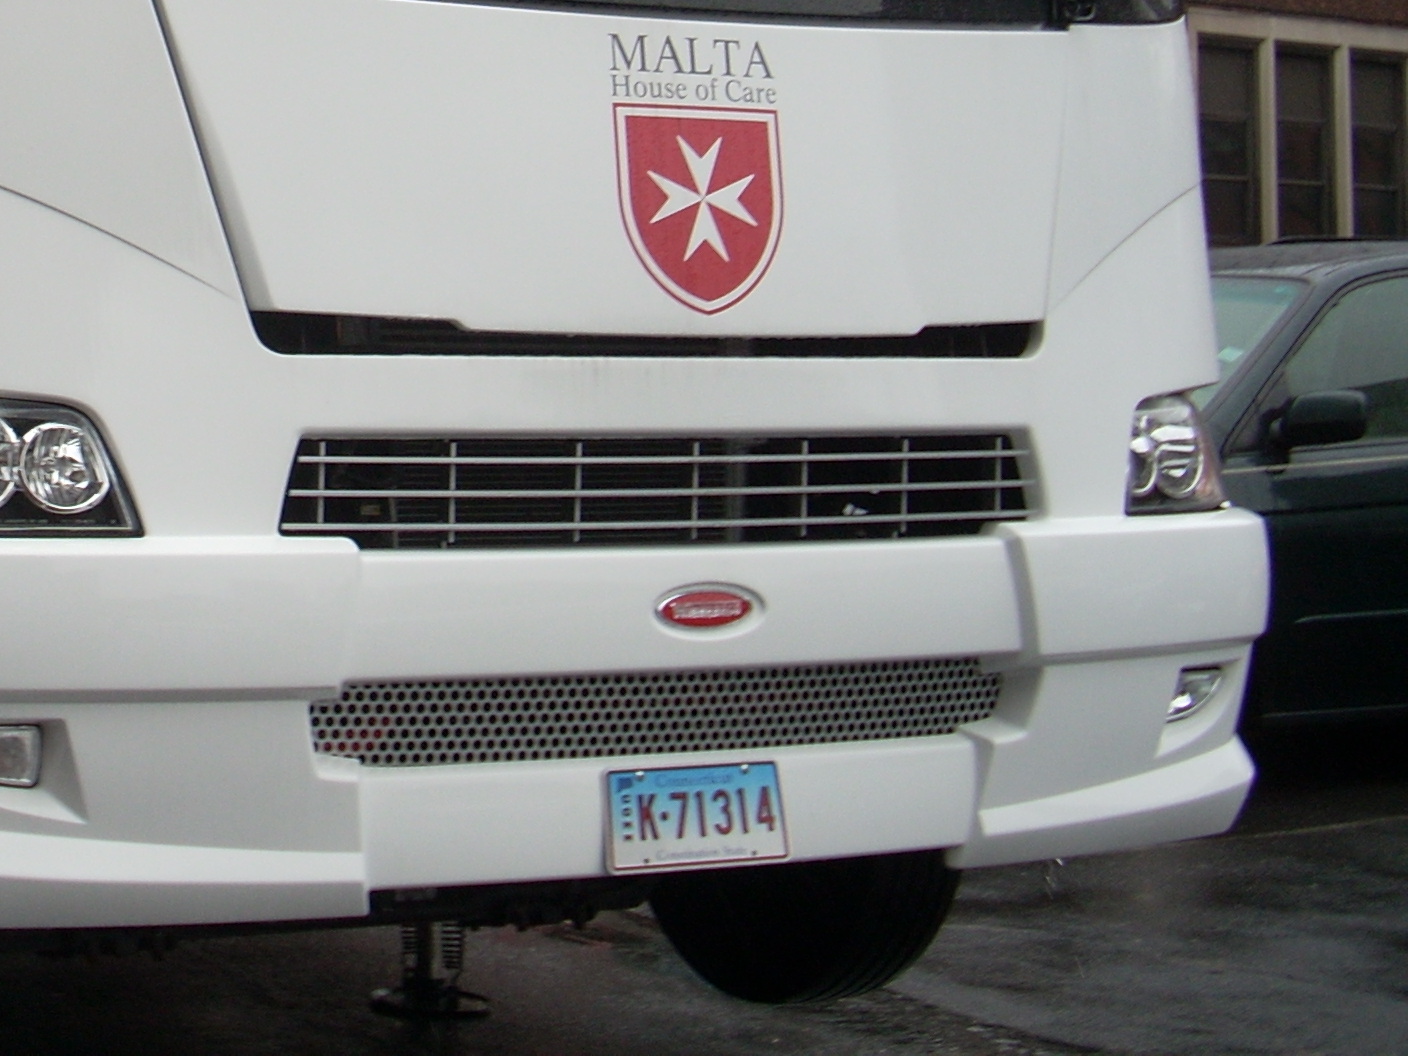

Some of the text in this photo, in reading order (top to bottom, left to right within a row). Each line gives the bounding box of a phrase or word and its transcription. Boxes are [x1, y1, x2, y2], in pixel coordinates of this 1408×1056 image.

[608, 32, 774, 79] MALTA
[610, 74, 778, 104] House of Care
